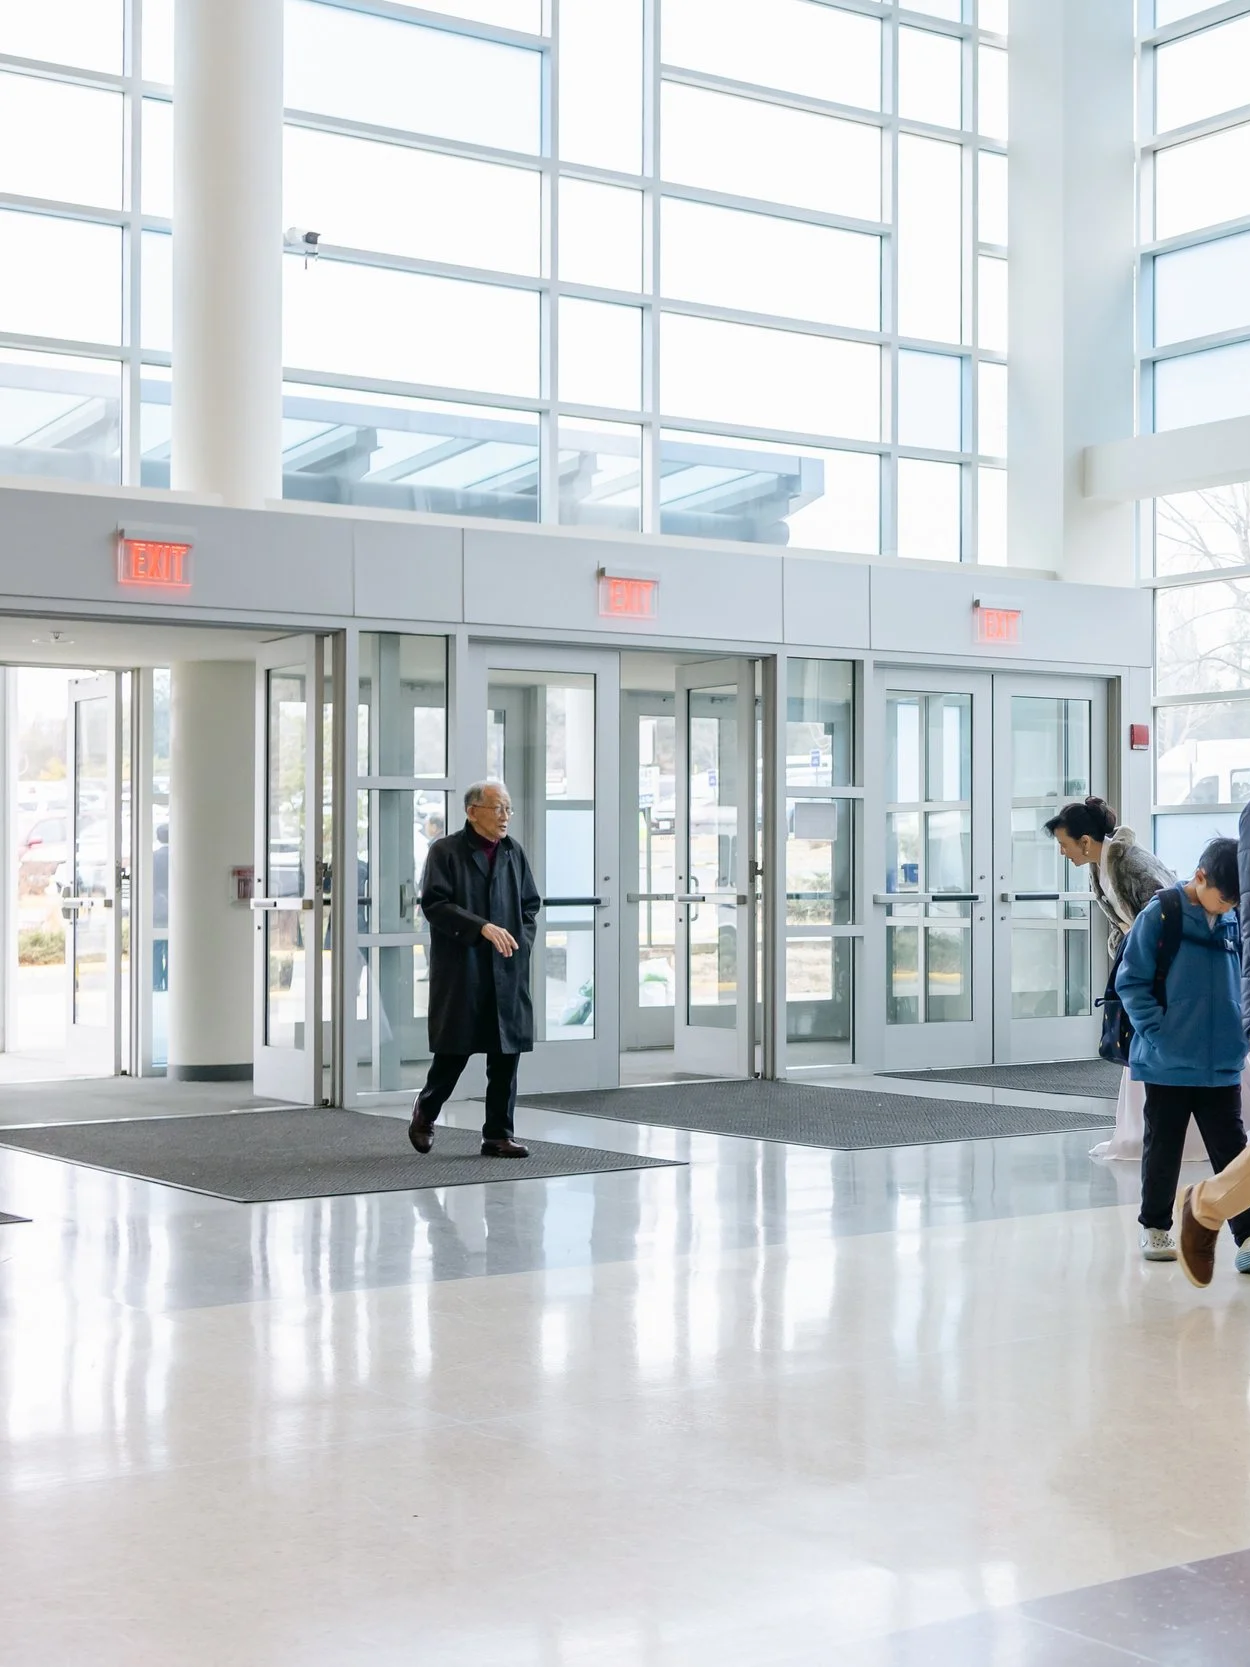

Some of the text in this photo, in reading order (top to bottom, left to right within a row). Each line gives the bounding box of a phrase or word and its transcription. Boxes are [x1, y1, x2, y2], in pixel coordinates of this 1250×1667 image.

[131, 542, 187, 581] EXIT
[610, 579, 653, 614] EXIT
[985, 609, 1018, 641] EXIT
